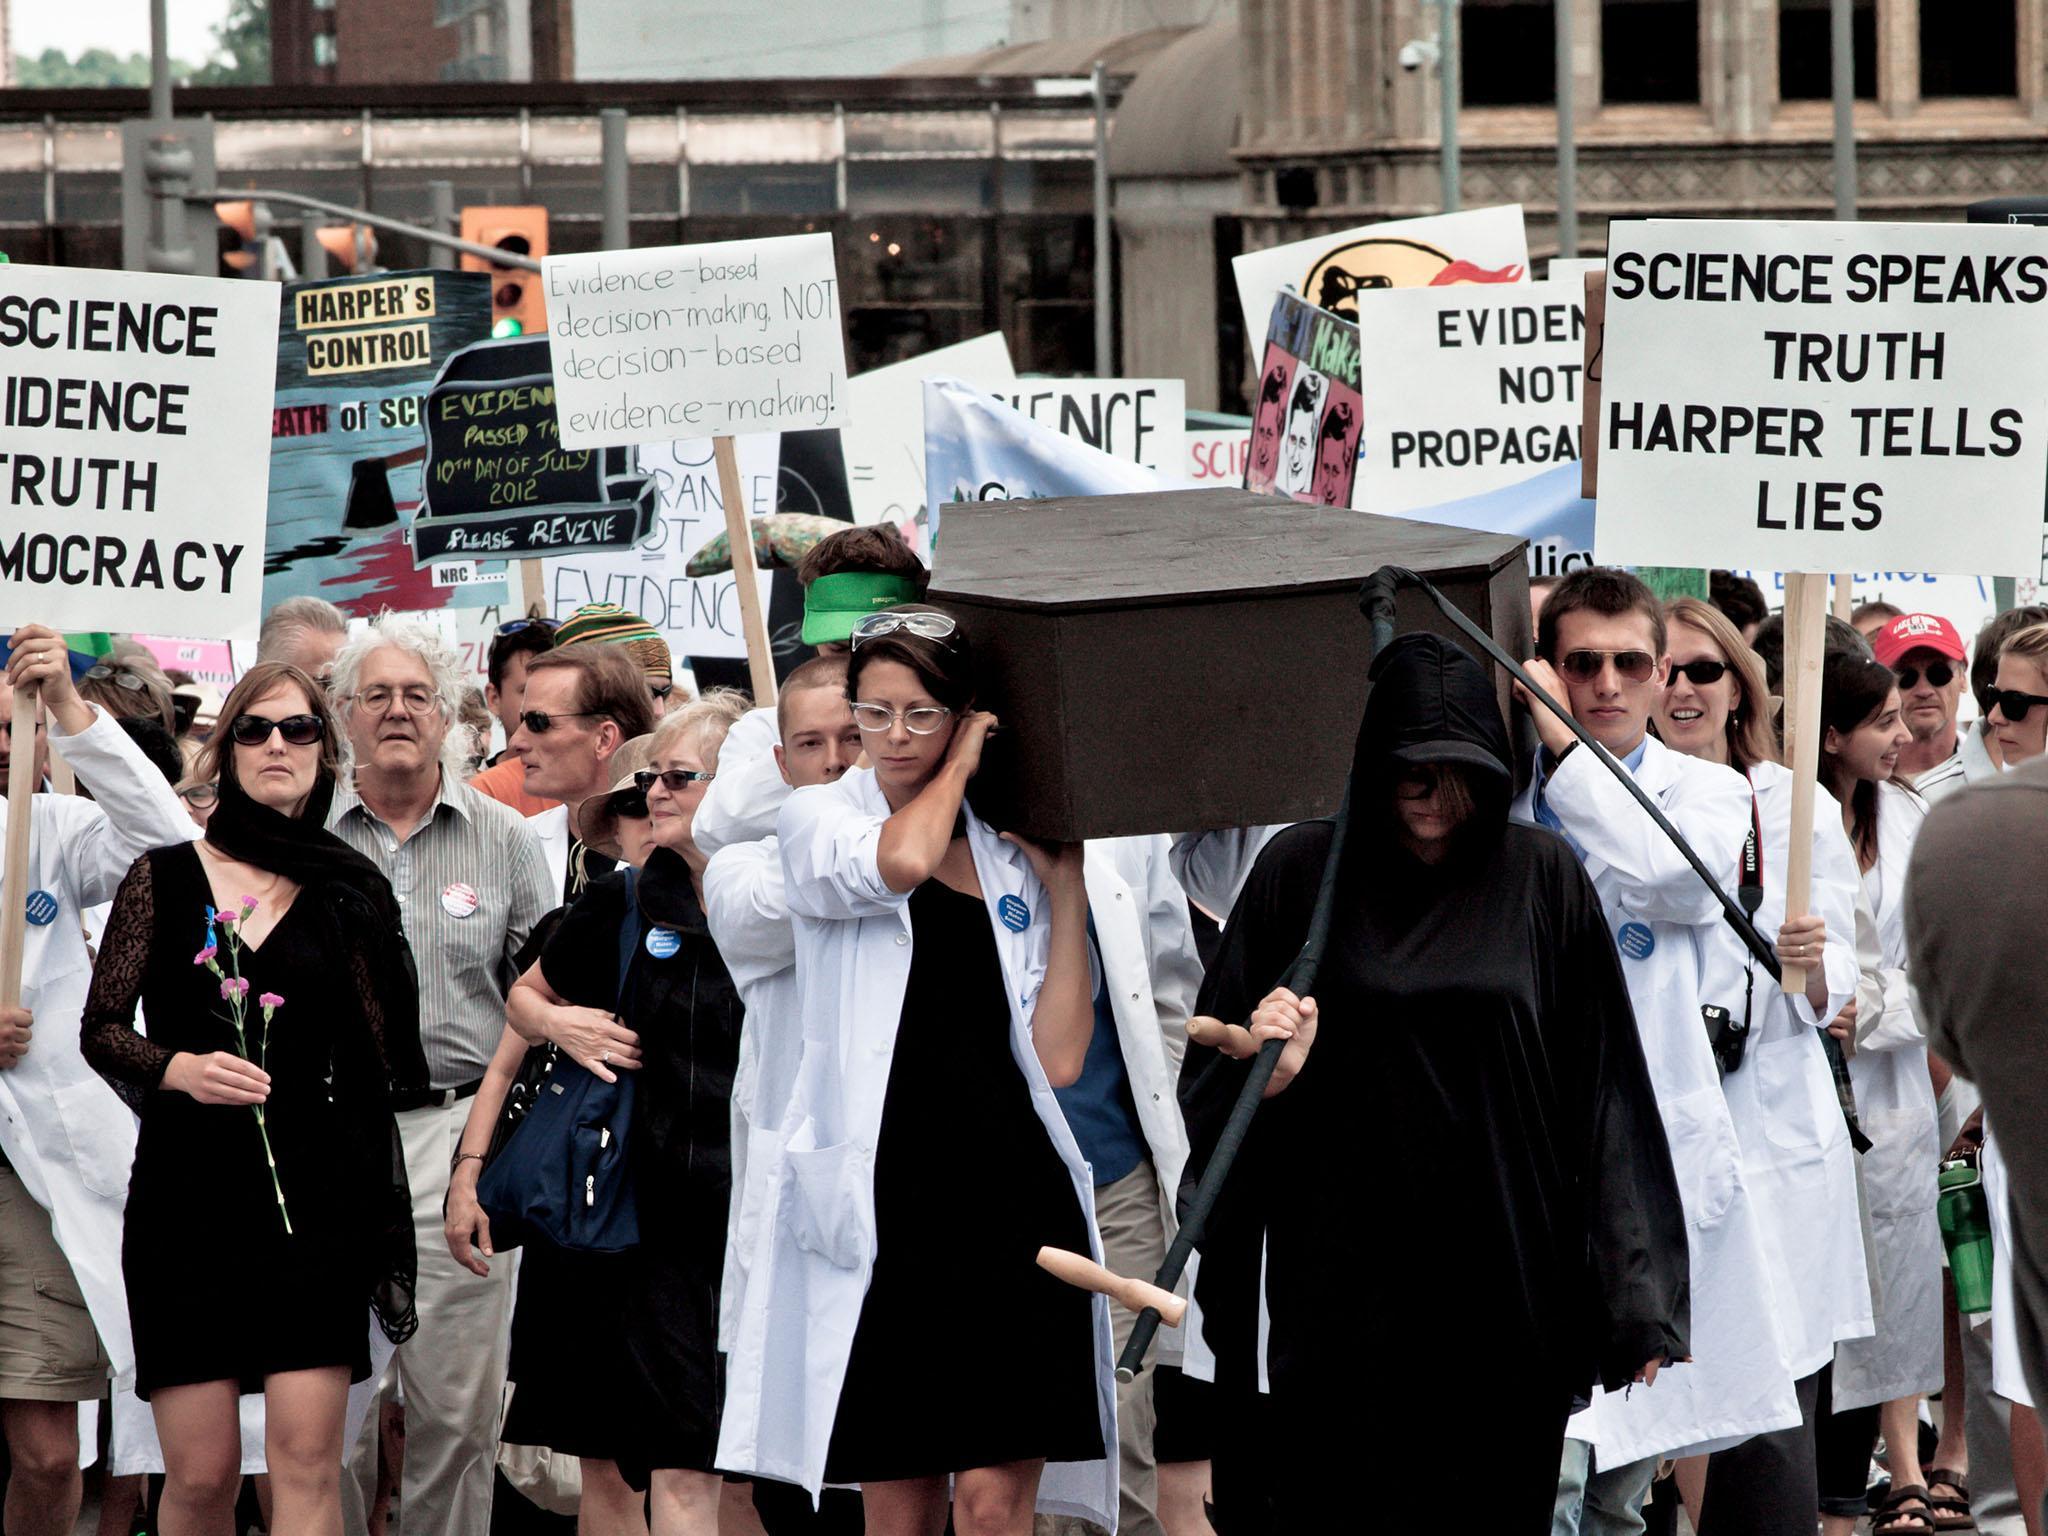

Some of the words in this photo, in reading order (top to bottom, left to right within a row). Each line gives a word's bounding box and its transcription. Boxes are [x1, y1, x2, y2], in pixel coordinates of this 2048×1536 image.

[551, 253, 759, 298] Evidence-based
[1611, 252, 1833, 304] SCIENCE
[1846, 255, 2048, 304] SPEAKS
[301, 284, 431, 325] HARPER's
[784, 279, 837, 321] NOT
[0, 295, 218, 358] SCIENCE
[1438, 304, 1586, 348] EVIDEN
[307, 329, 430, 370] CONTROL
[563, 331, 802, 381] decision-based
[1311, 317, 1361, 385] Make
[1763, 330, 1945, 383] TRUTH
[5, 376, 190, 436] IDENCE
[441, 386, 557, 421] EVIDEN
[569, 374, 837, 436] evidence-making!
[1498, 365, 1583, 405] NOT
[273, 403, 328, 438] ATH
[340, 400, 368, 431] of
[379, 394, 425, 429] SCI
[464, 424, 529, 449] PASSED
[1608, 401, 1824, 458] HARPER
[1850, 406, 2024, 458] TELLS
[474, 457, 503, 483] DAY
[505, 457, 531, 476] OF
[532, 448, 591, 477] JULY
[1191, 439, 1251, 480] SCI
[1391, 425, 1583, 469] PROPAGA
[489, 479, 539, 504] 2012
[1756, 480, 1884, 532] LIES
[446, 527, 518, 550] PLEASE
[528, 514, 617, 546] REVIVE
[640, 518, 700, 553] OT
[0, 531, 245, 594] MOCRACY
[439, 566, 469, 584] NRC
[554, 567, 737, 637] EVIDENC
[1745, 827, 1756, 872] Canon
